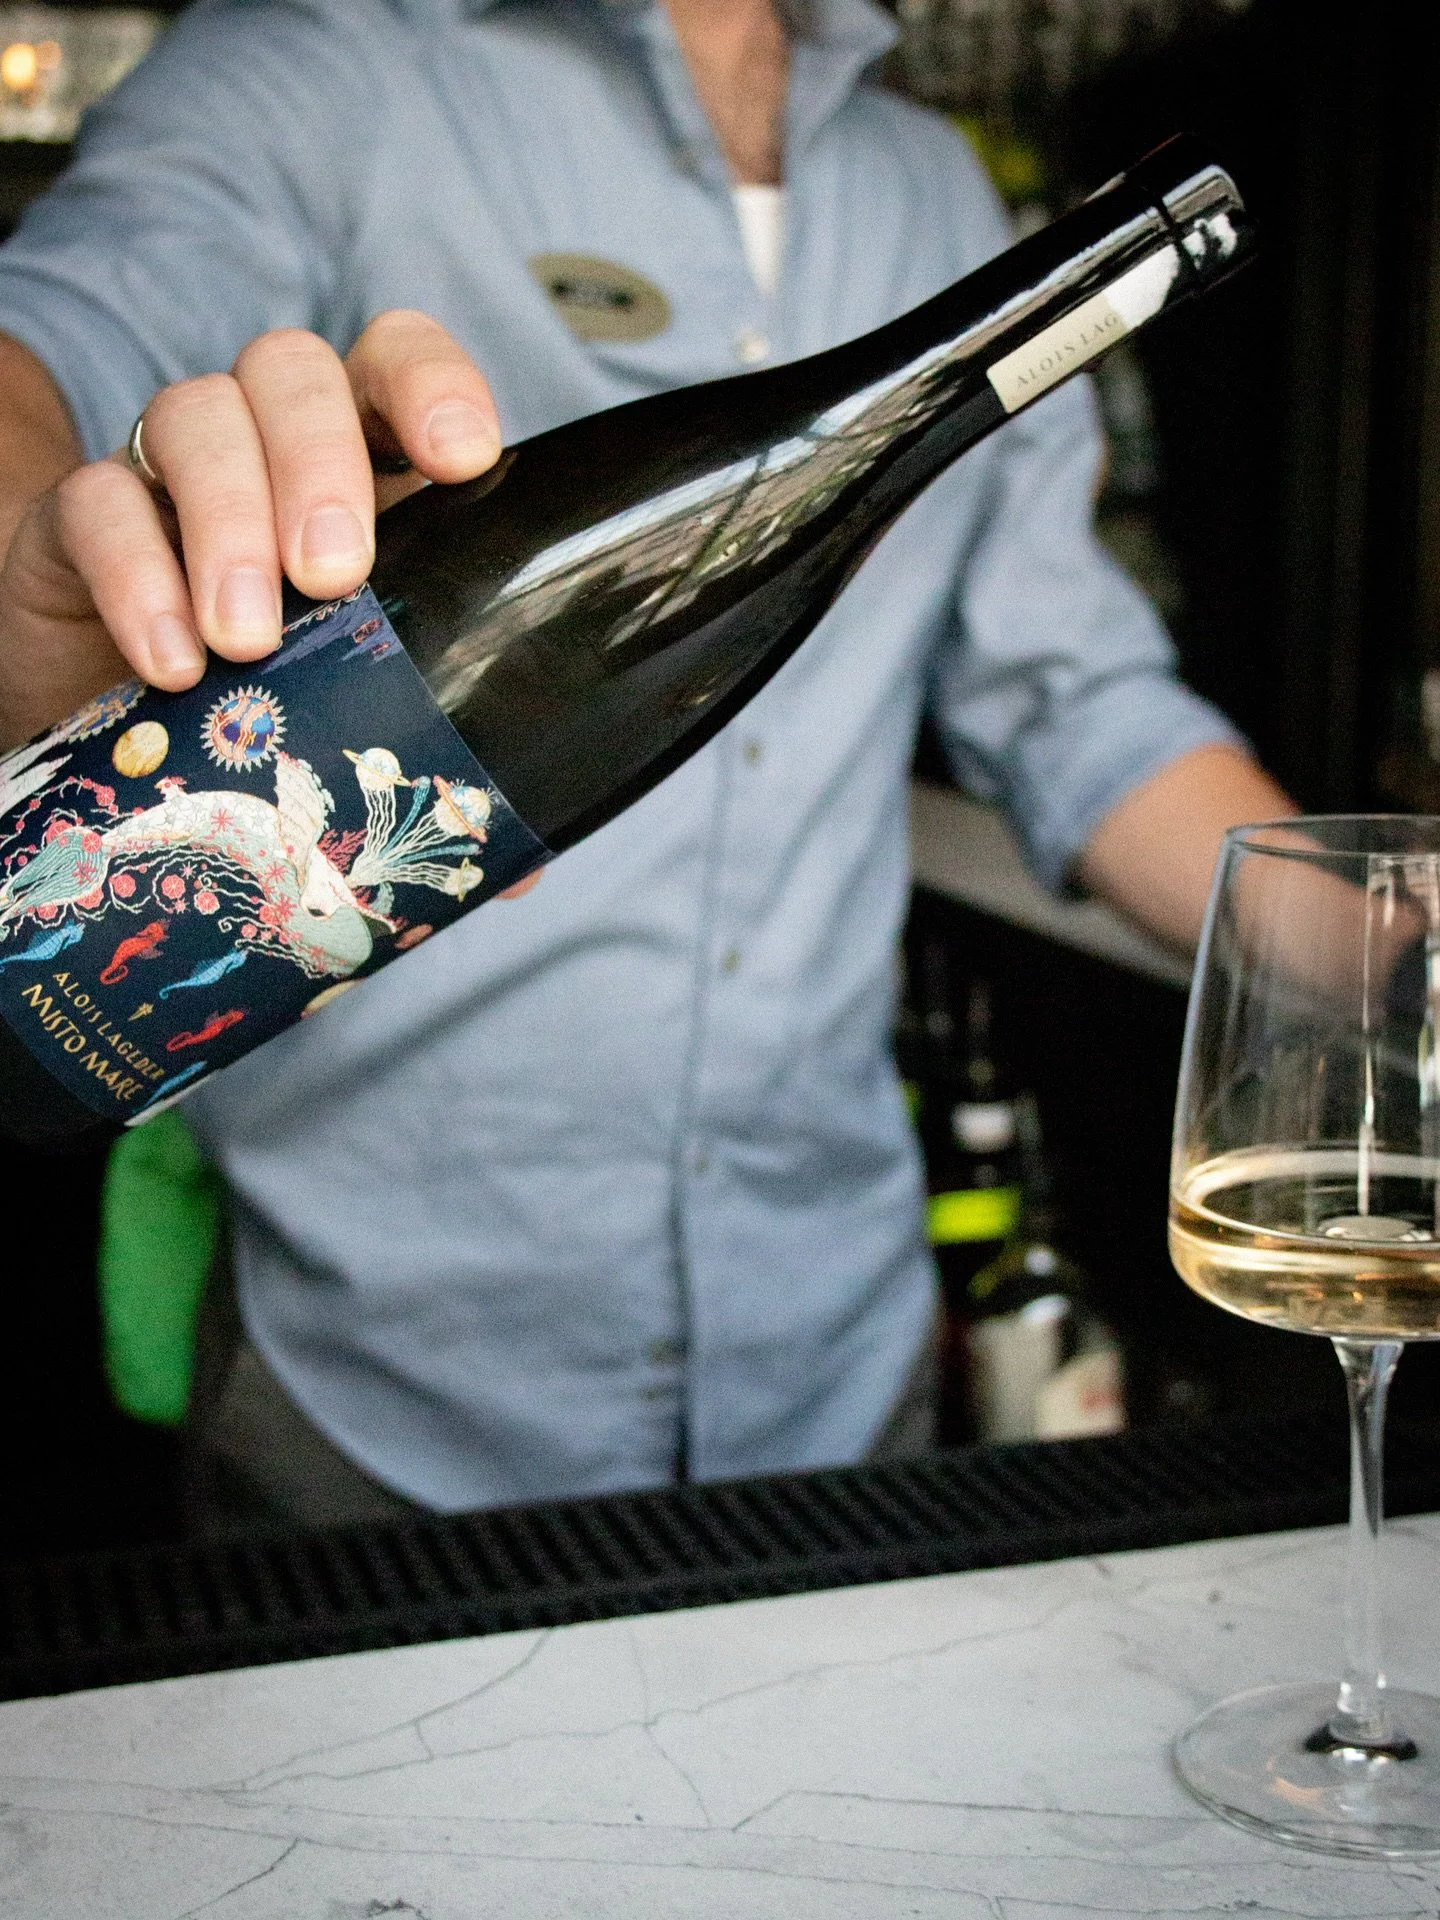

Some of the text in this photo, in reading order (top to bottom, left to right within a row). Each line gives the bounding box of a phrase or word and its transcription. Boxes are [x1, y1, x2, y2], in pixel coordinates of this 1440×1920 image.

[1016, 344, 1076, 388] ALOIS
[21, 983, 144, 1101] MISTO MARE
[53, 971, 166, 1081] ALOIS LAGEDER
